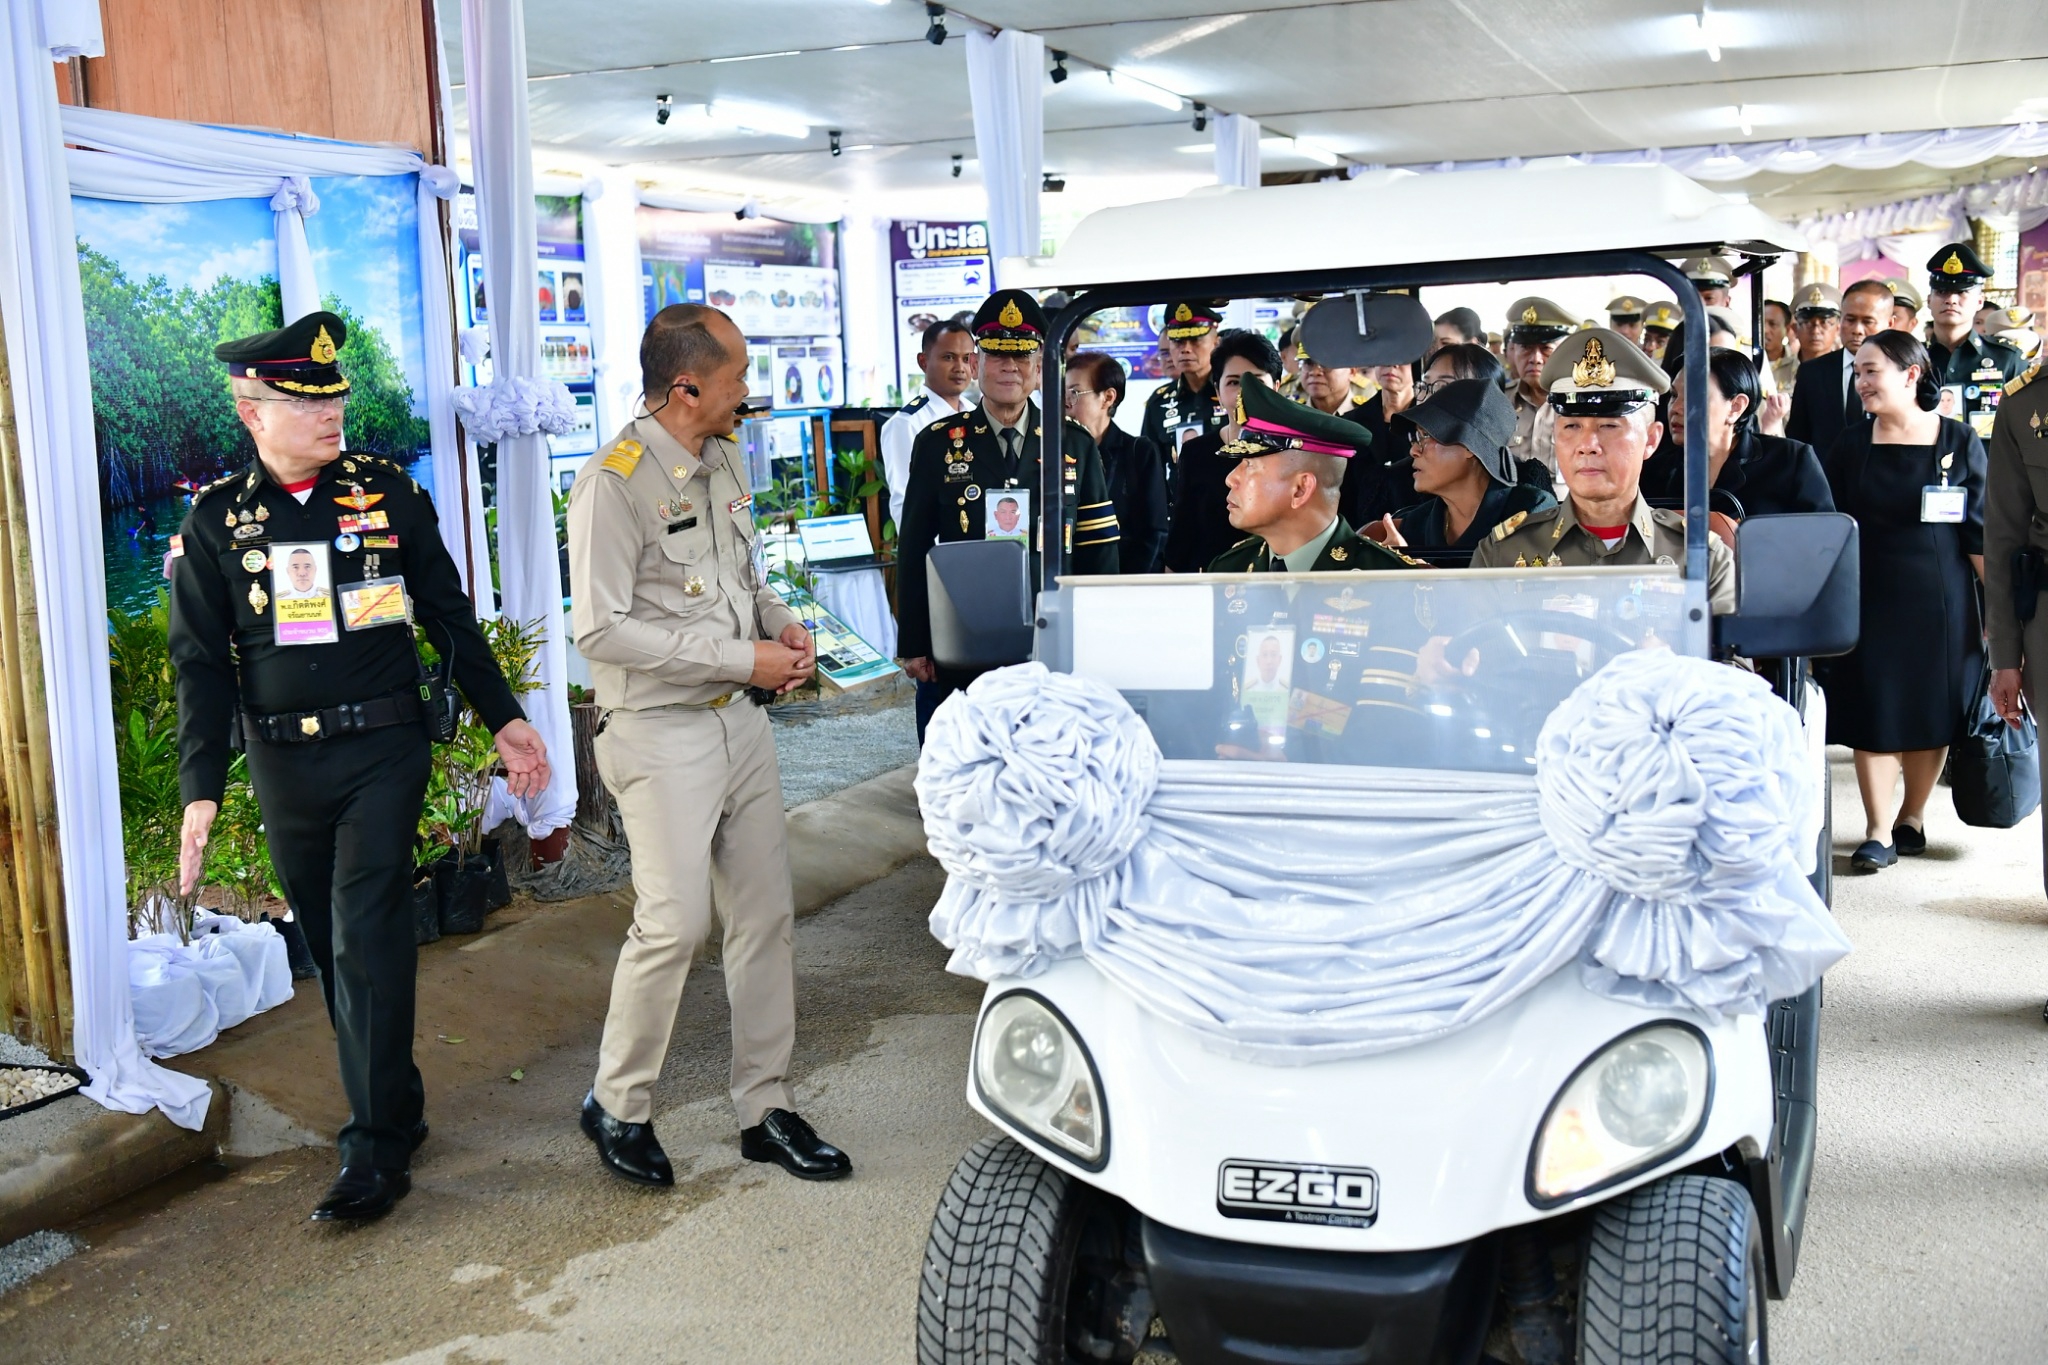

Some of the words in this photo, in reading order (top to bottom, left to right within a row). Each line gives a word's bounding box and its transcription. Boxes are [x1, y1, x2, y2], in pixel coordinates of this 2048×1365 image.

[906, 222, 988, 259] ปูทะเล
[1284, 1211, 1293, 1220] A
[1294, 1211, 1327, 1222] Textron
